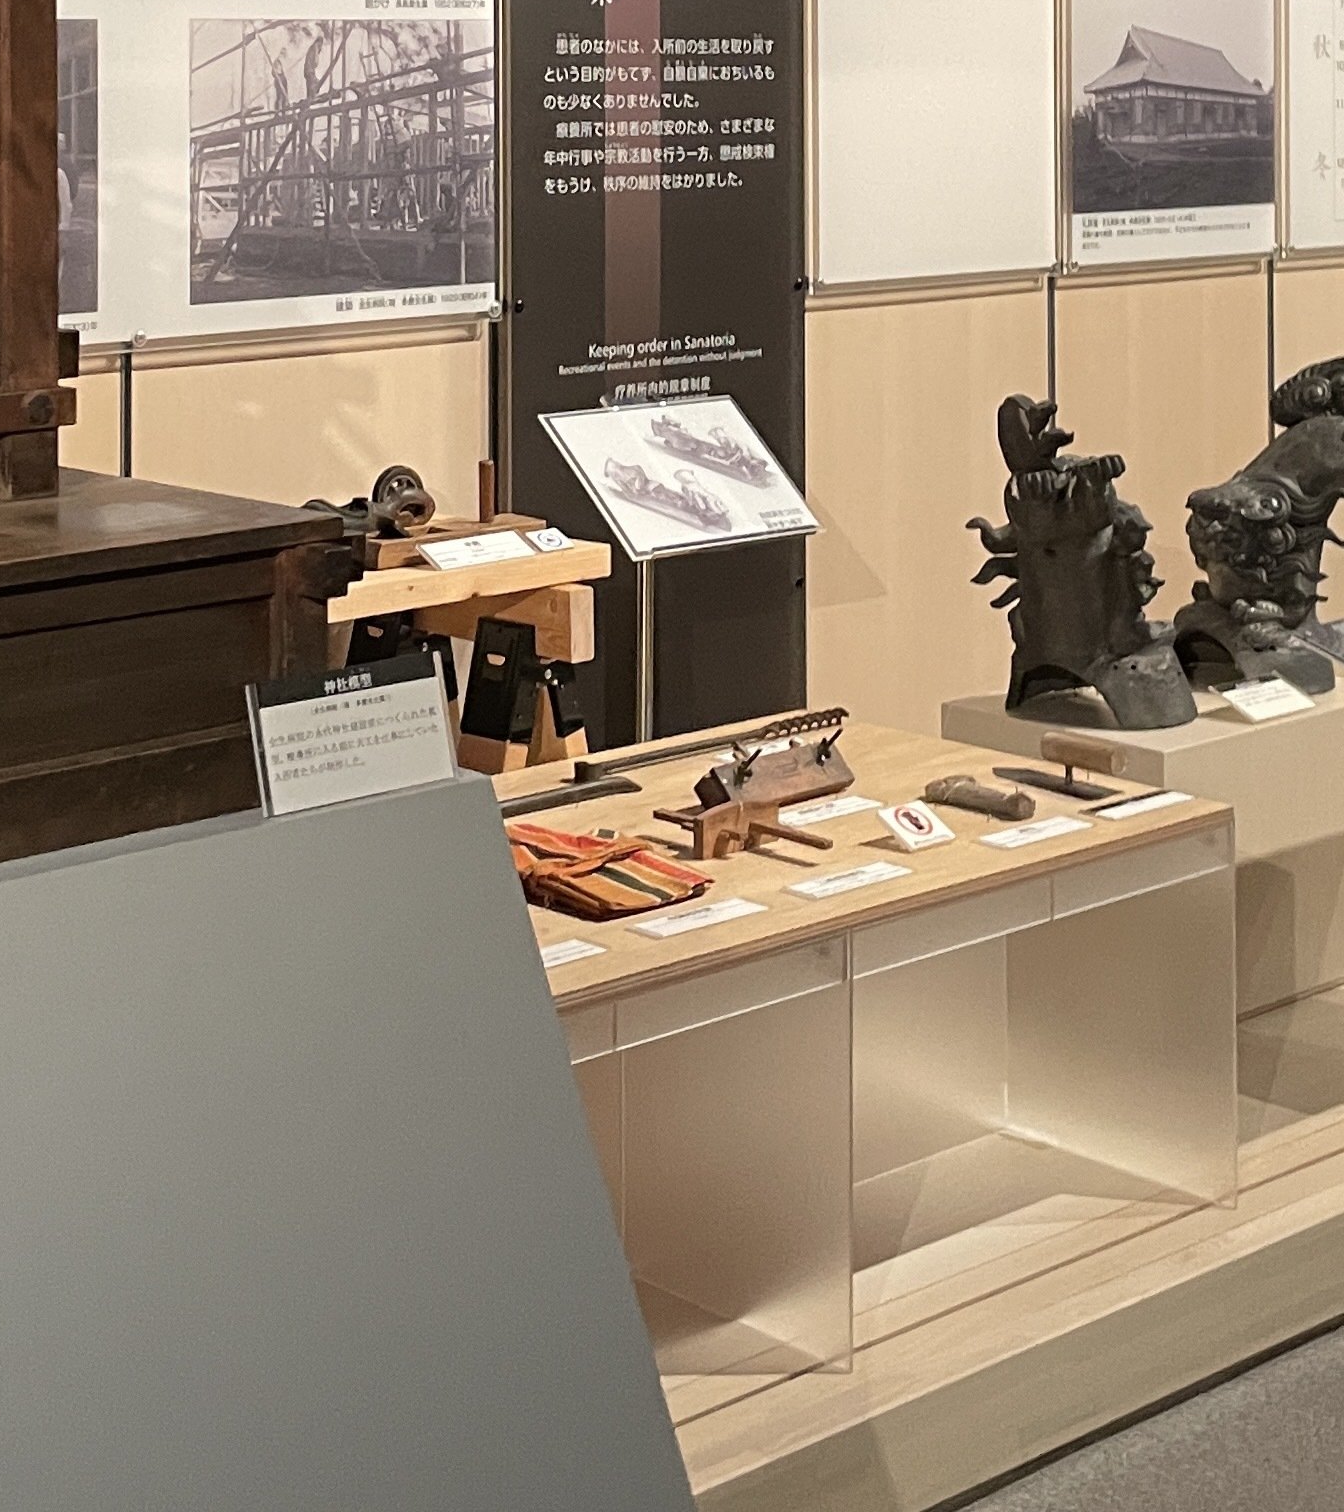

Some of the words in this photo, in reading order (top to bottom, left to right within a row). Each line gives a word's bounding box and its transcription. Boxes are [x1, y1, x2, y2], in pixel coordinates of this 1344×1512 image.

[543, 93, 699, 110] のも少なくありませんでした。
[588, 343, 635, 360] Keeping
[637, 338, 667, 354] order
[671, 337, 681, 351] in
[685, 334, 735, 350] Sanatoria
[324, 672, 372, 695] 神社模型
